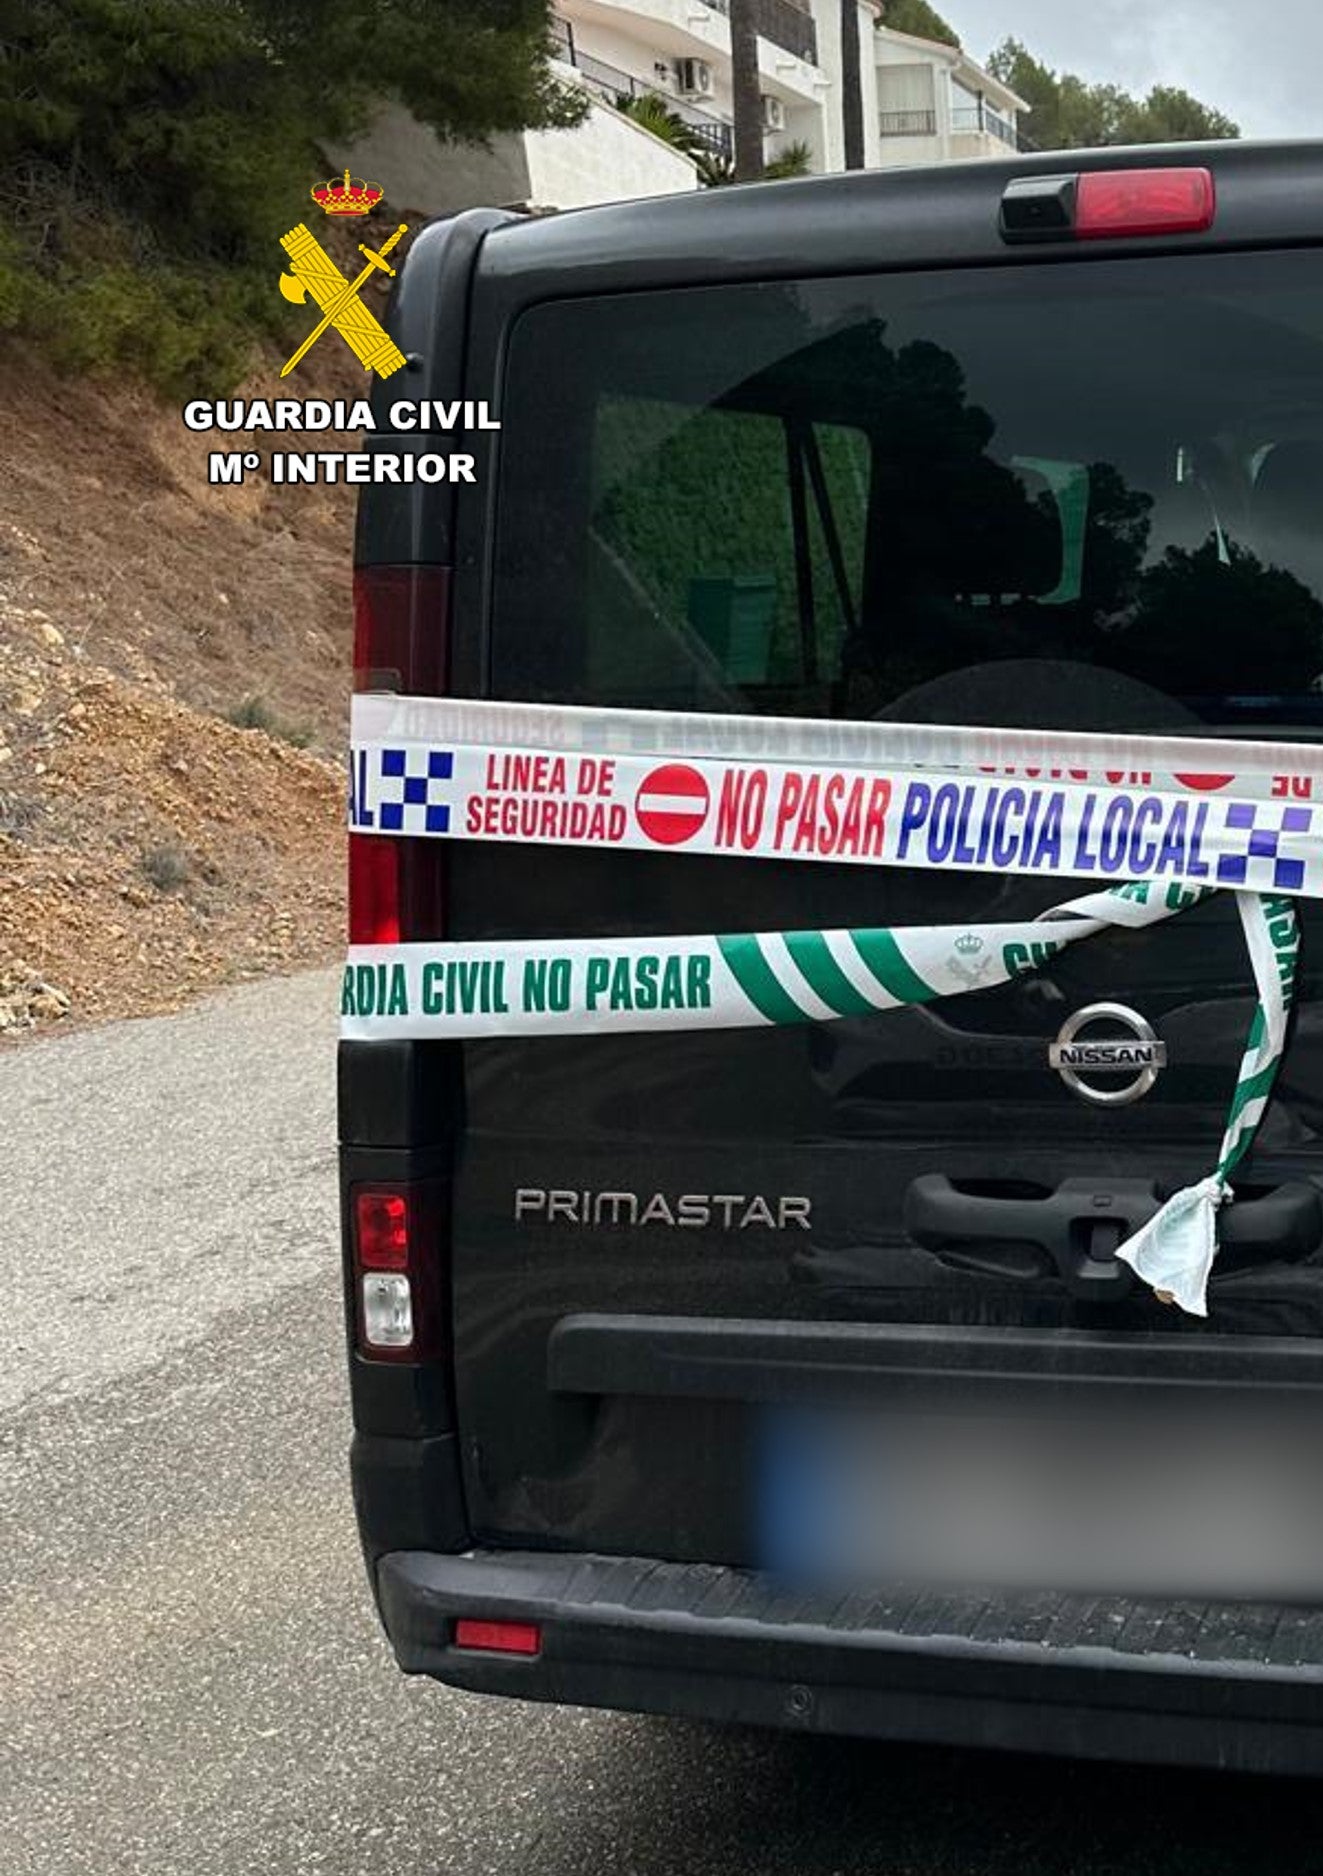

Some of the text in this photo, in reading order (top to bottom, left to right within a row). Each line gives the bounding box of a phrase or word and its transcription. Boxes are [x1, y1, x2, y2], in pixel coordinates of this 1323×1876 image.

[486, 753, 616, 798] LINEA DE
[466, 794, 628, 842] SEGURIDAD
[714, 767, 1210, 877] NO PASAR POLICIA LOCAL
[421, 959, 508, 1014] CIVIL
[523, 957, 572, 1012] NO
[585, 954, 711, 1010] PASAR
[1059, 1047, 1152, 1065] NISSAN
[514, 1188, 812, 1230] PRIMASTAR
